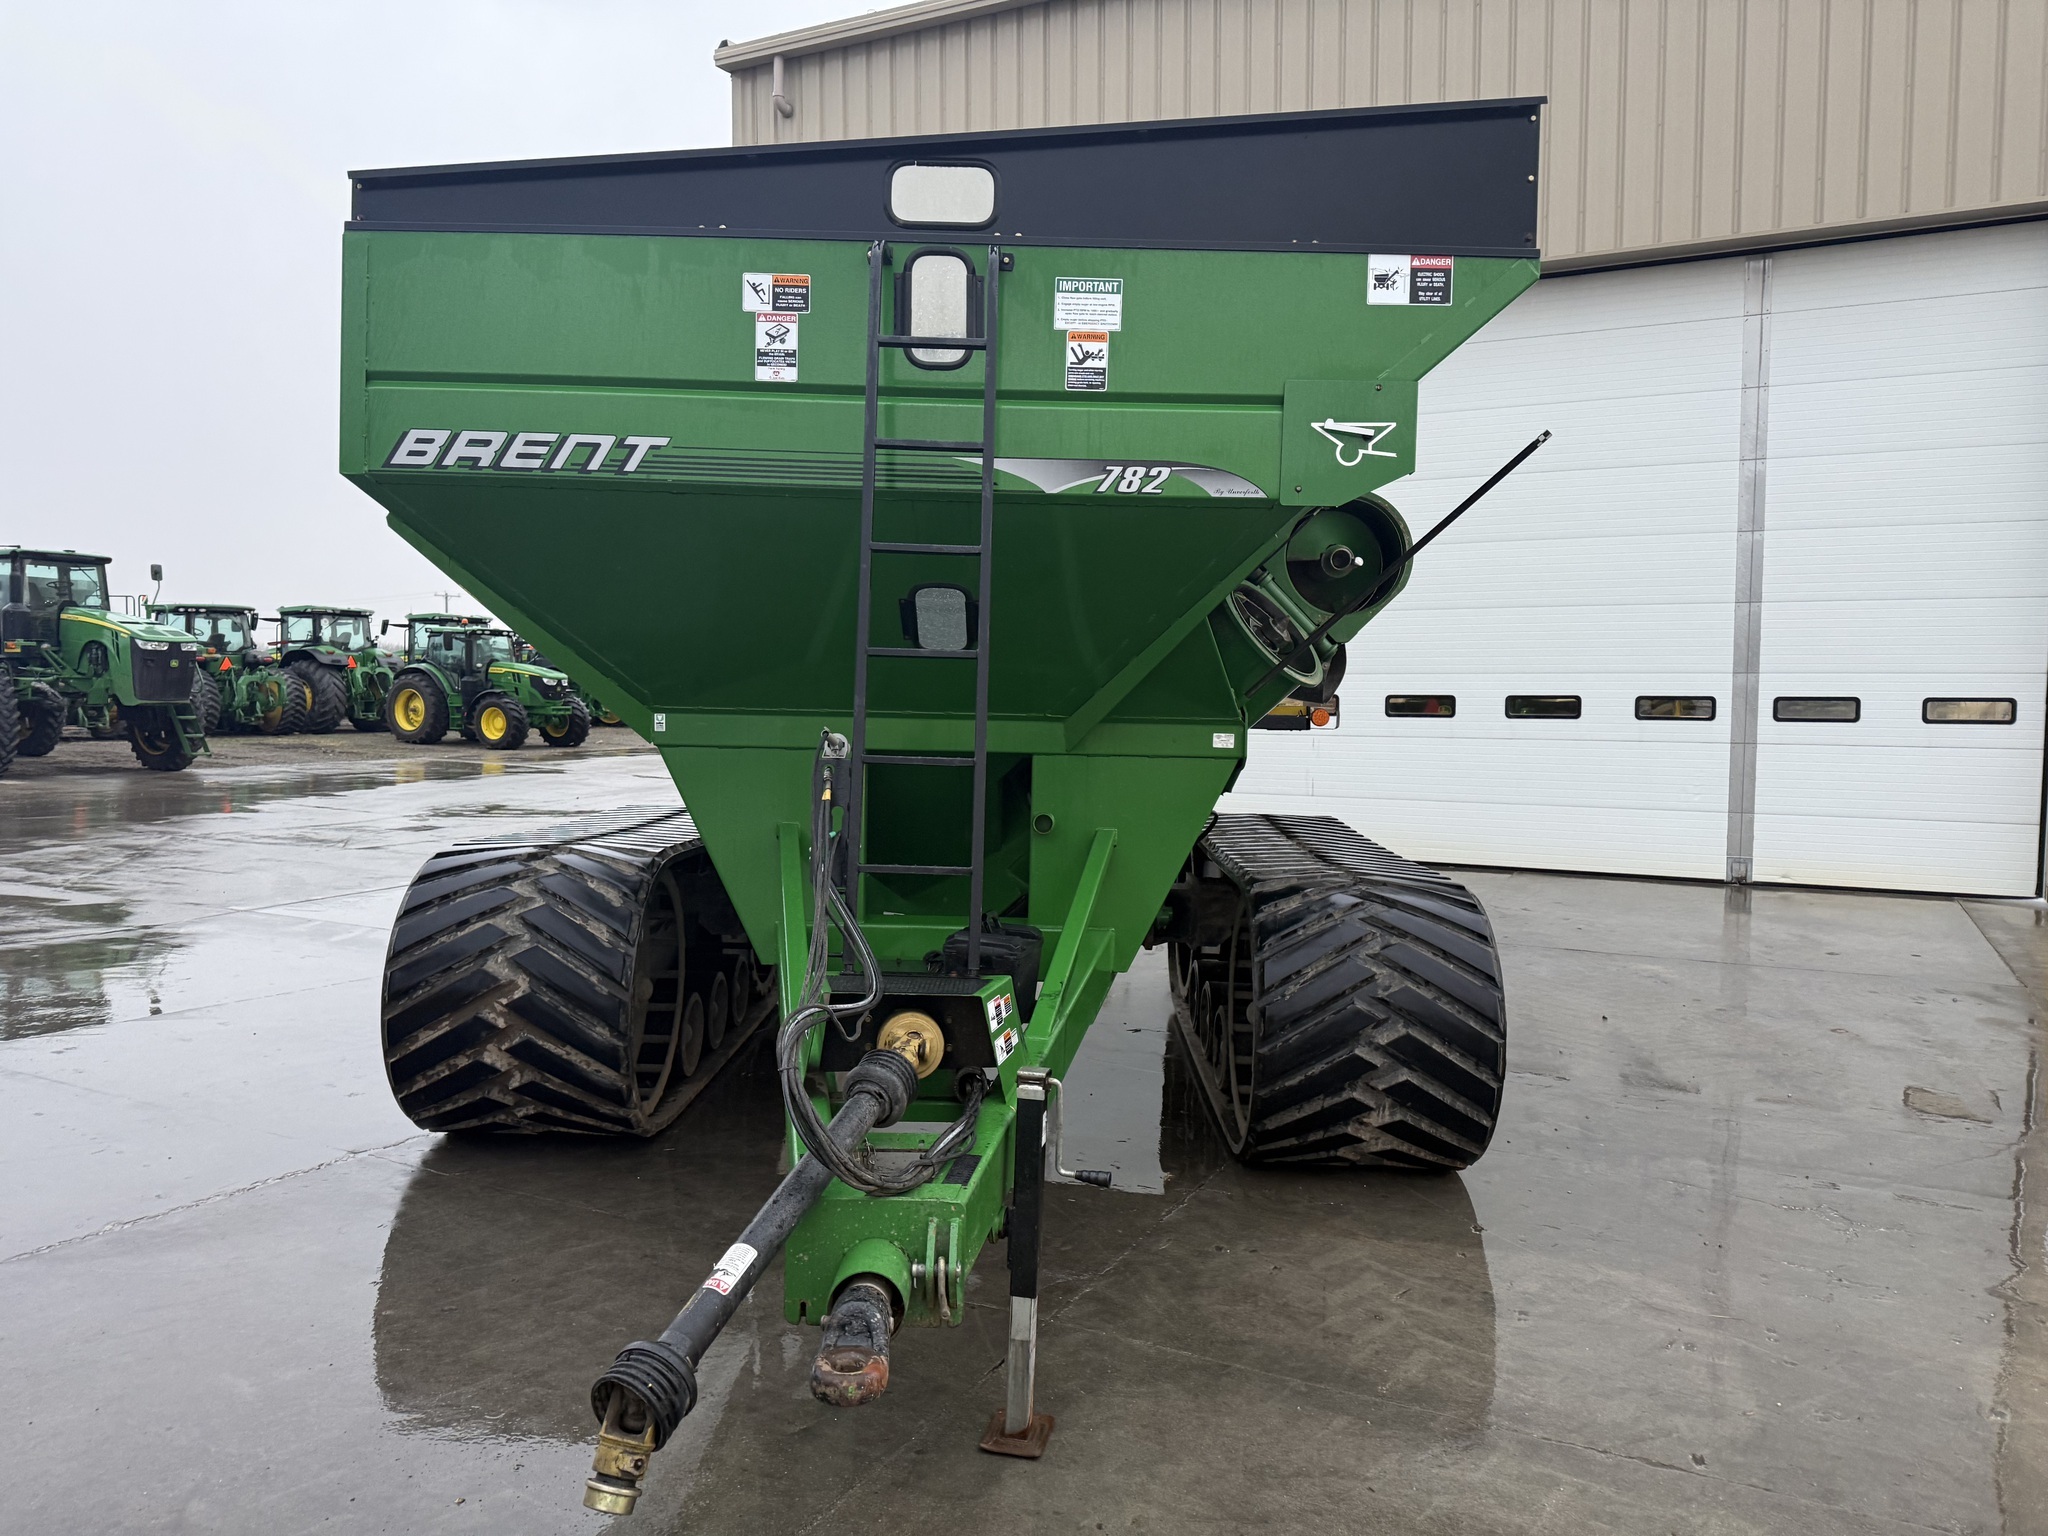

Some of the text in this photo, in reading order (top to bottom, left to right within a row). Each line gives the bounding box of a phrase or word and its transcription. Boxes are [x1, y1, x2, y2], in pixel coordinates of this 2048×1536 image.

[1420, 258, 1451, 266] DANGER
[1059, 280, 1119, 293] IMPORTANT
[384, 428, 672, 475] BRENT
[1094, 465, 1172, 495] 782
